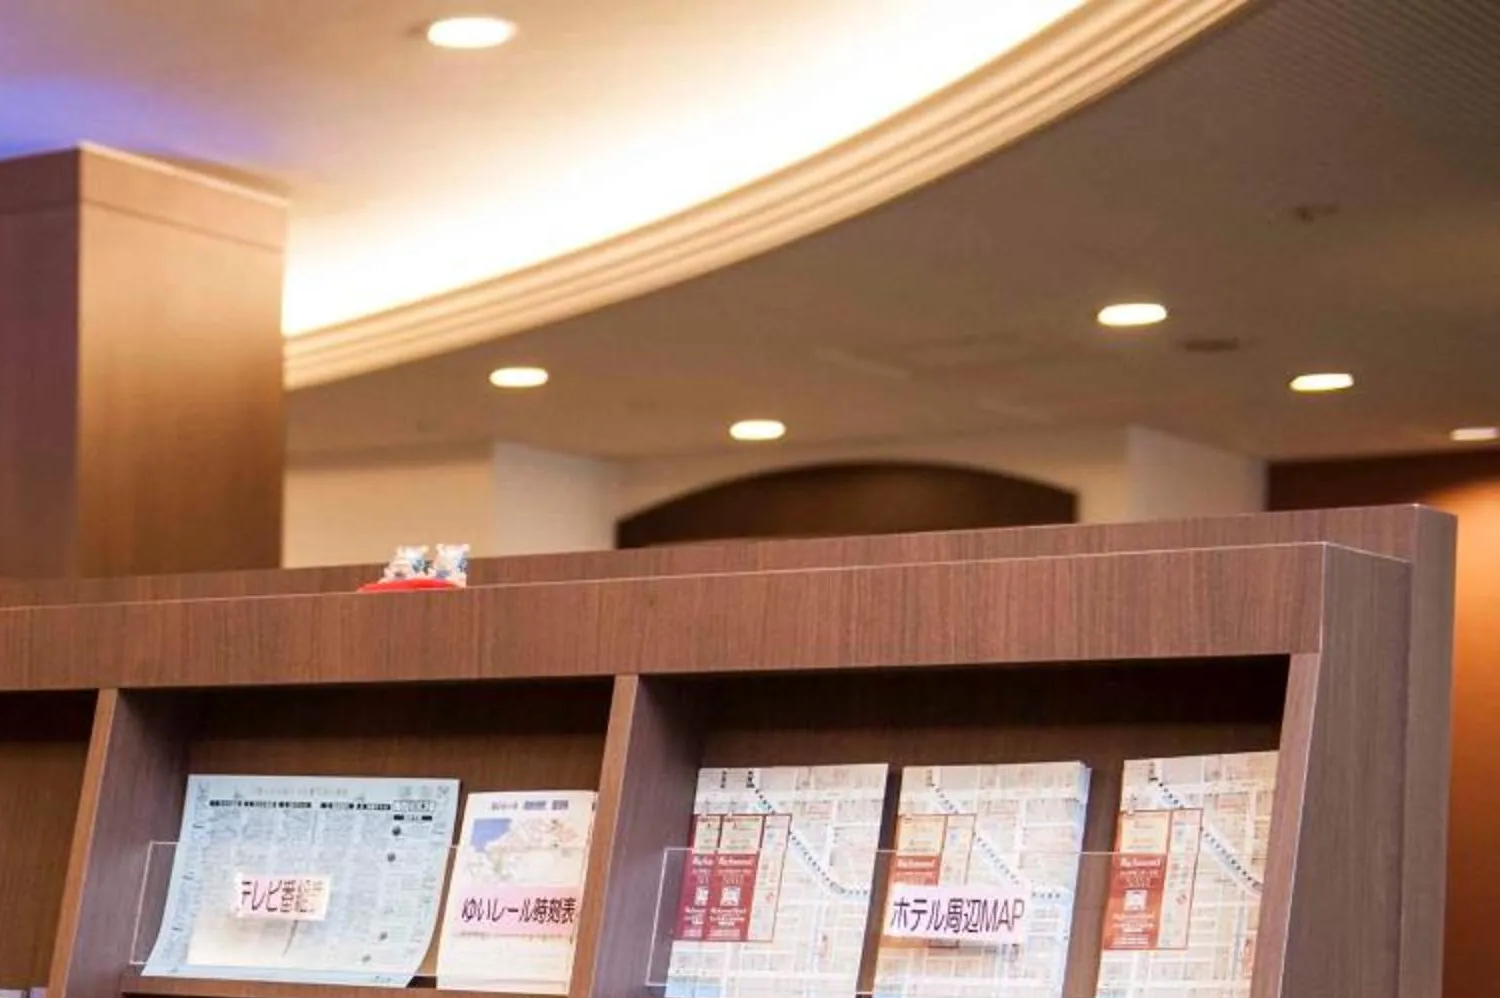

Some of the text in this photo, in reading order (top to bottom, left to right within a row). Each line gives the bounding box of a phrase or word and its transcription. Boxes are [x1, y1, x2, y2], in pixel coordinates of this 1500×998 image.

[461, 897, 577, 925] ゆいレール時刻表
[890, 897, 1025, 934] ホテル周辺MAP
